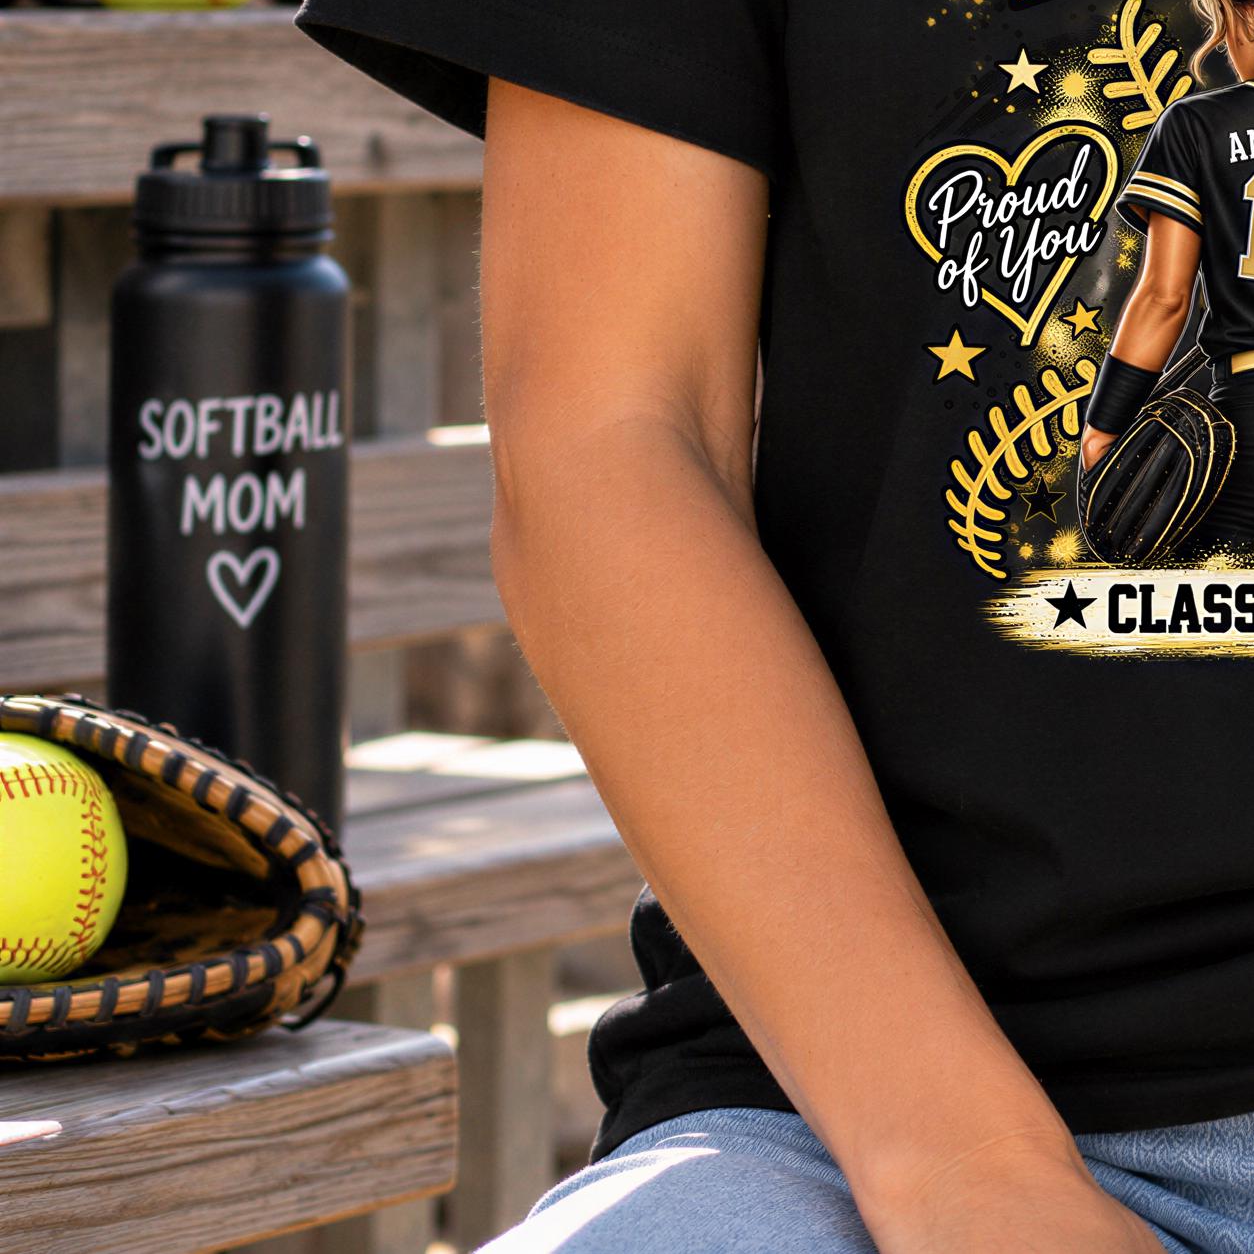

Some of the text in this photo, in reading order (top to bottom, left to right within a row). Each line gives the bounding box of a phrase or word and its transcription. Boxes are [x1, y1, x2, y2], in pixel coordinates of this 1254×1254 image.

[928, 144, 1090, 248] Proud
[937, 217, 1103, 307] of You
[139, 390, 344, 460] SOFTBALL
[181, 469, 305, 535] MOM
